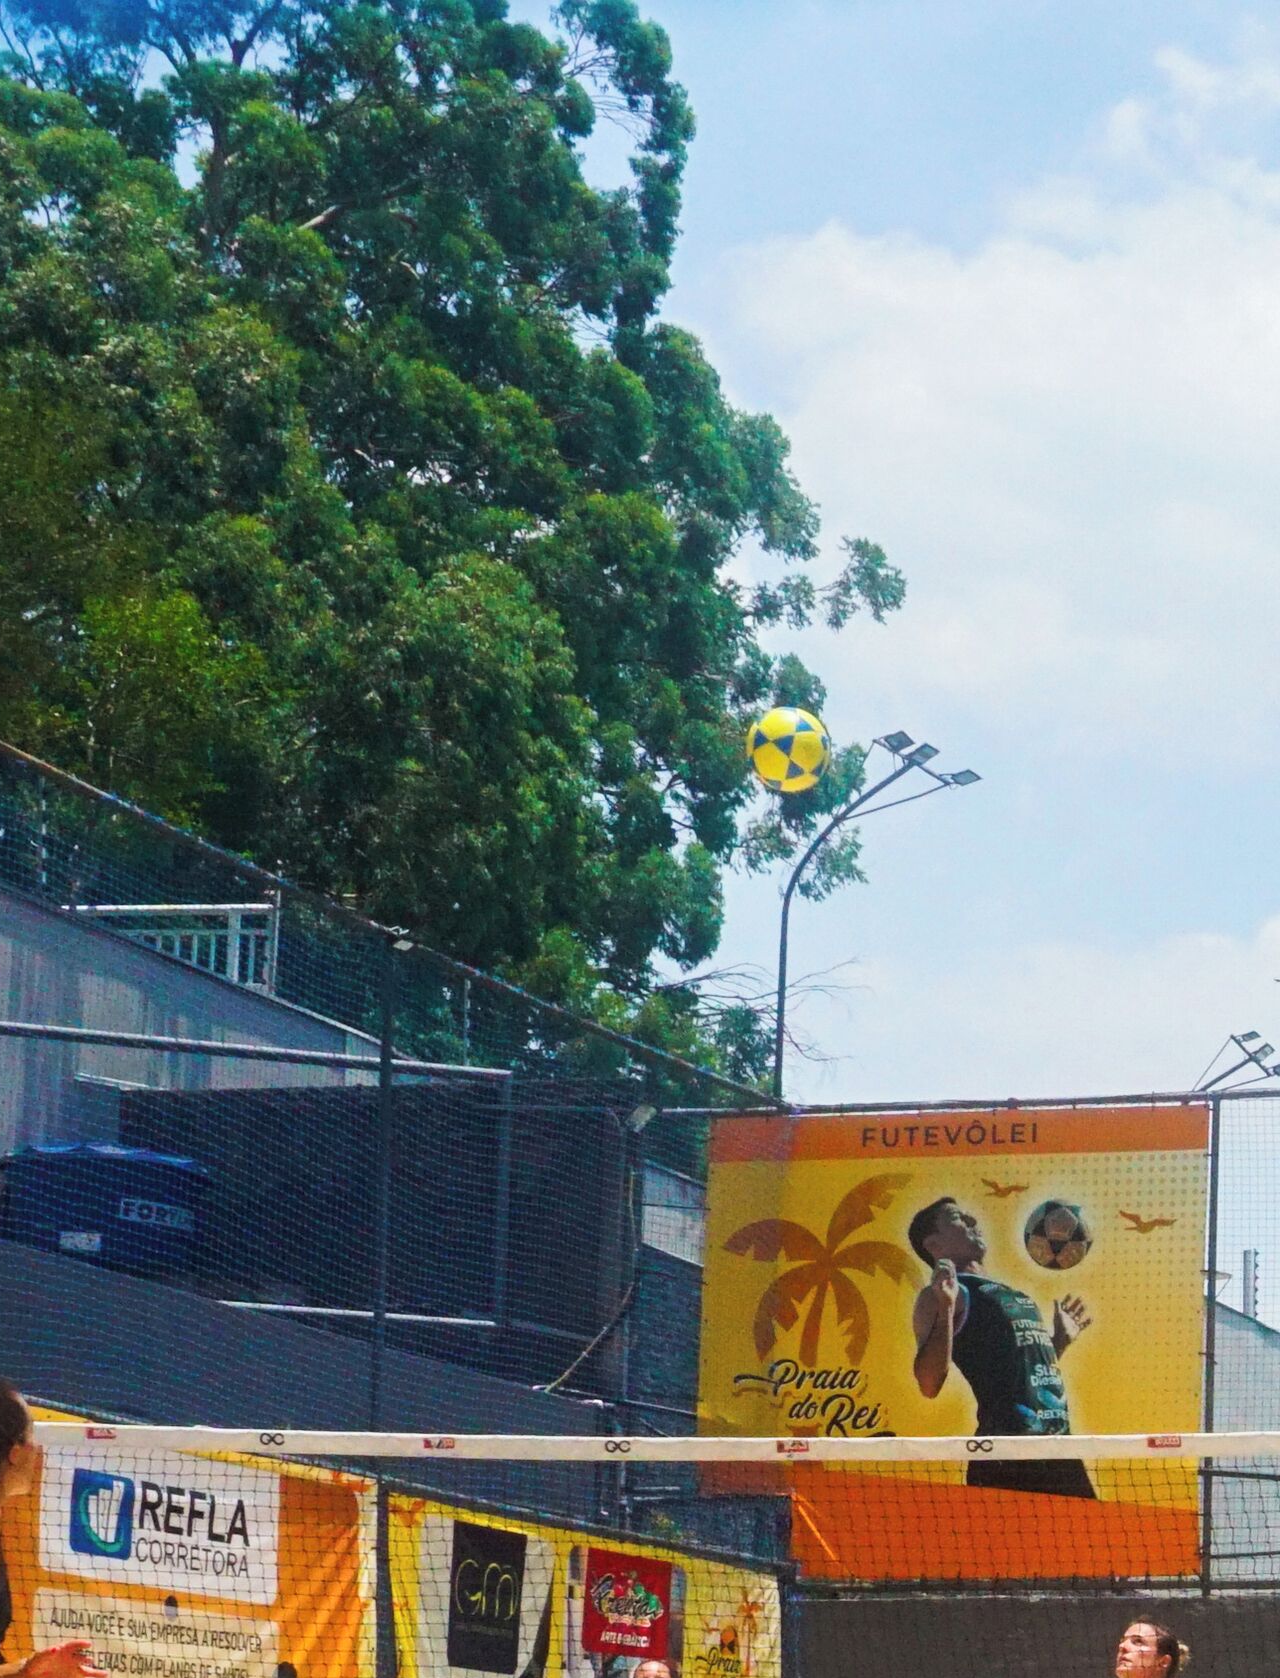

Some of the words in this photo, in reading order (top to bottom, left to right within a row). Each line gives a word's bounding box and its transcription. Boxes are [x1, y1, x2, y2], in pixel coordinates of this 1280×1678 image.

[861, 1120, 1038, 1148] FUTEVÔLEI
[734, 1358, 861, 1397] Praia
[788, 1393, 818, 1419] do
[820, 1393, 882, 1437] Rei
[138, 1480, 251, 1548] REFLA
[135, 1536, 250, 1578] CORRETORA
[50, 1607, 85, 1630] AJUDA
[86, 1611, 116, 1635] VOCÊ
[118, 1616, 125, 1636] E
[127, 1618, 147, 1639] SUA
[150, 1621, 199, 1645] EMPRESA
[201, 1629, 210, 1647] A
[211, 1630, 263, 1654] RESOLVER
[129, 1655, 153, 1675] COM
